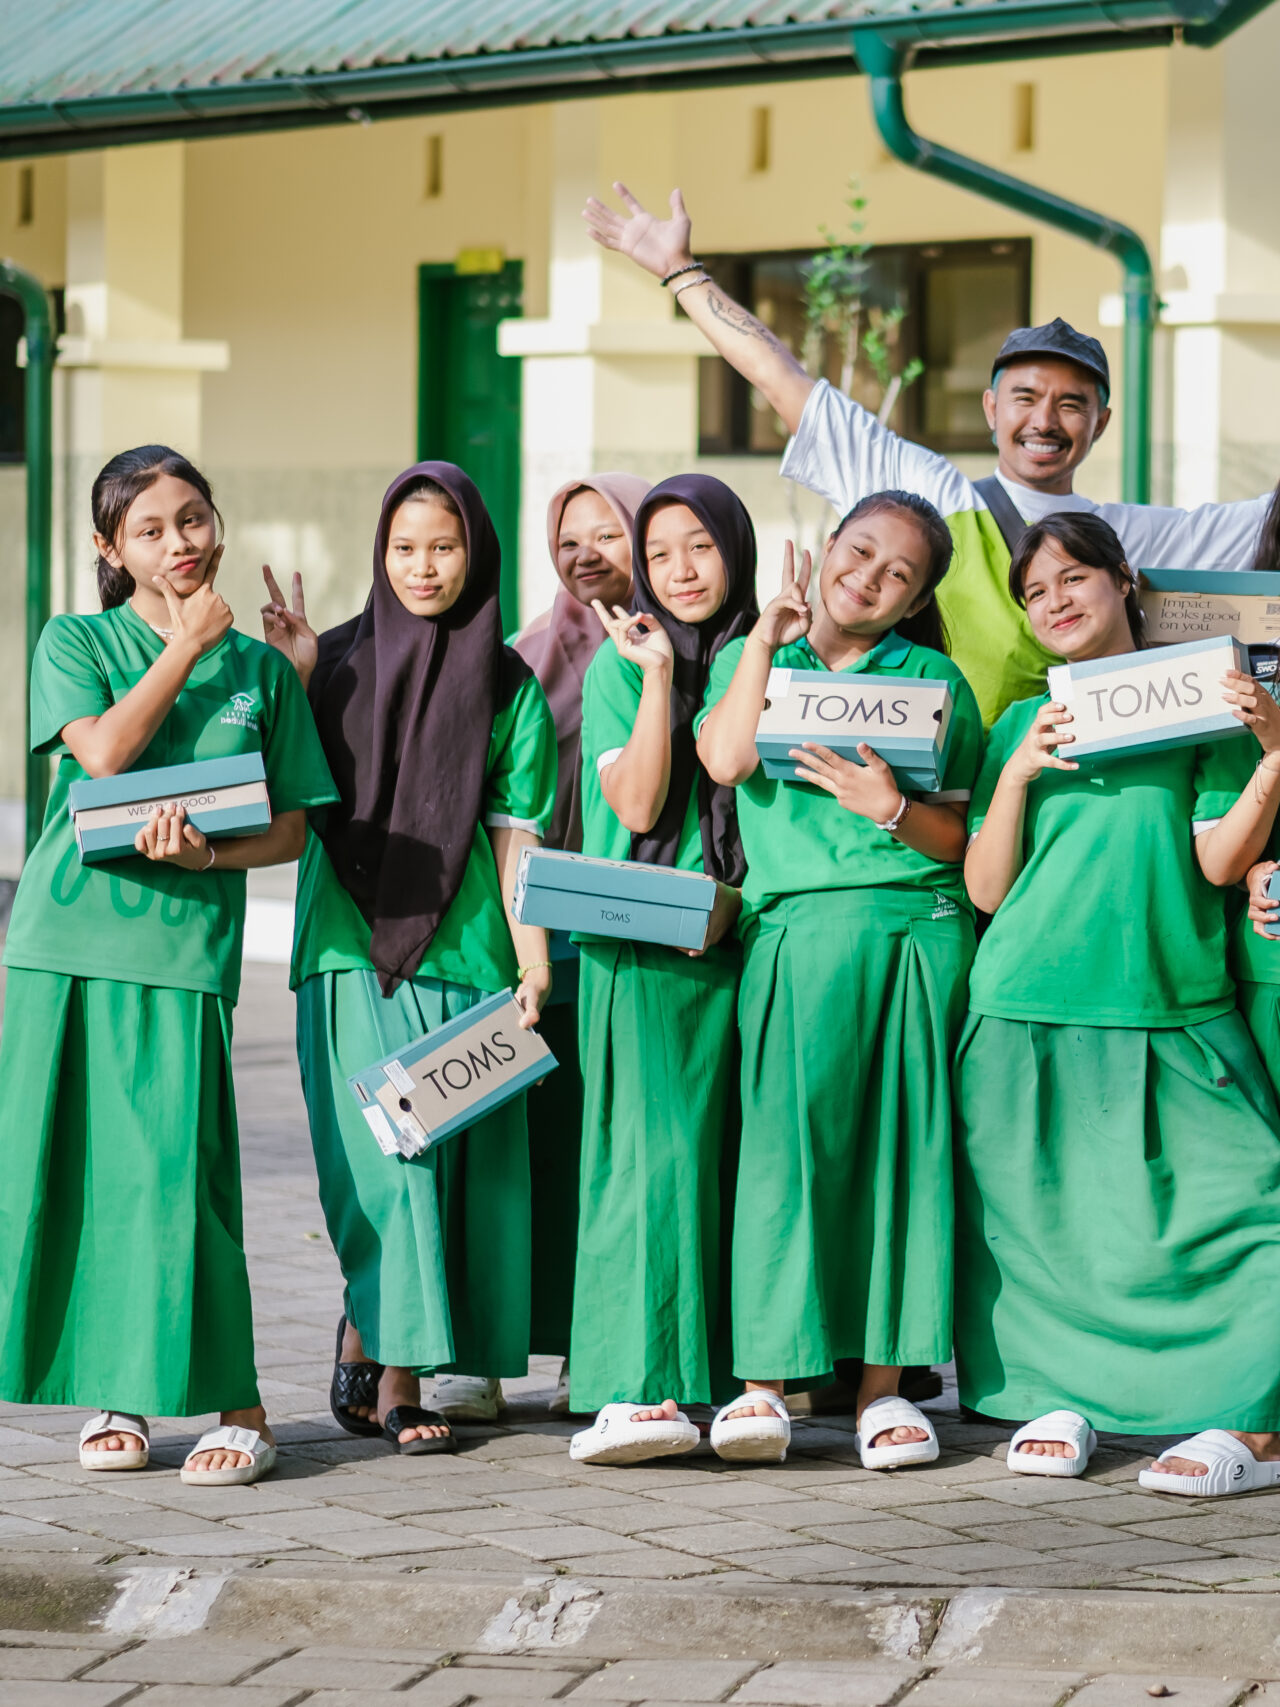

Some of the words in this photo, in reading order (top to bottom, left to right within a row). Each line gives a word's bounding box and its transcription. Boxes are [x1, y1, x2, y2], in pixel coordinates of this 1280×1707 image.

[1163, 598, 1212, 611] Impact
[1160, 608, 1199, 618] looks
[1203, 611, 1241, 622] good
[1159, 622, 1178, 631] on
[1087, 672, 1203, 722] TOMS
[798, 694, 909, 726] TOMS
[180, 795, 217, 810] GOOD
[600, 909, 631, 924] TOMS
[422, 1031, 516, 1100] TOMS
